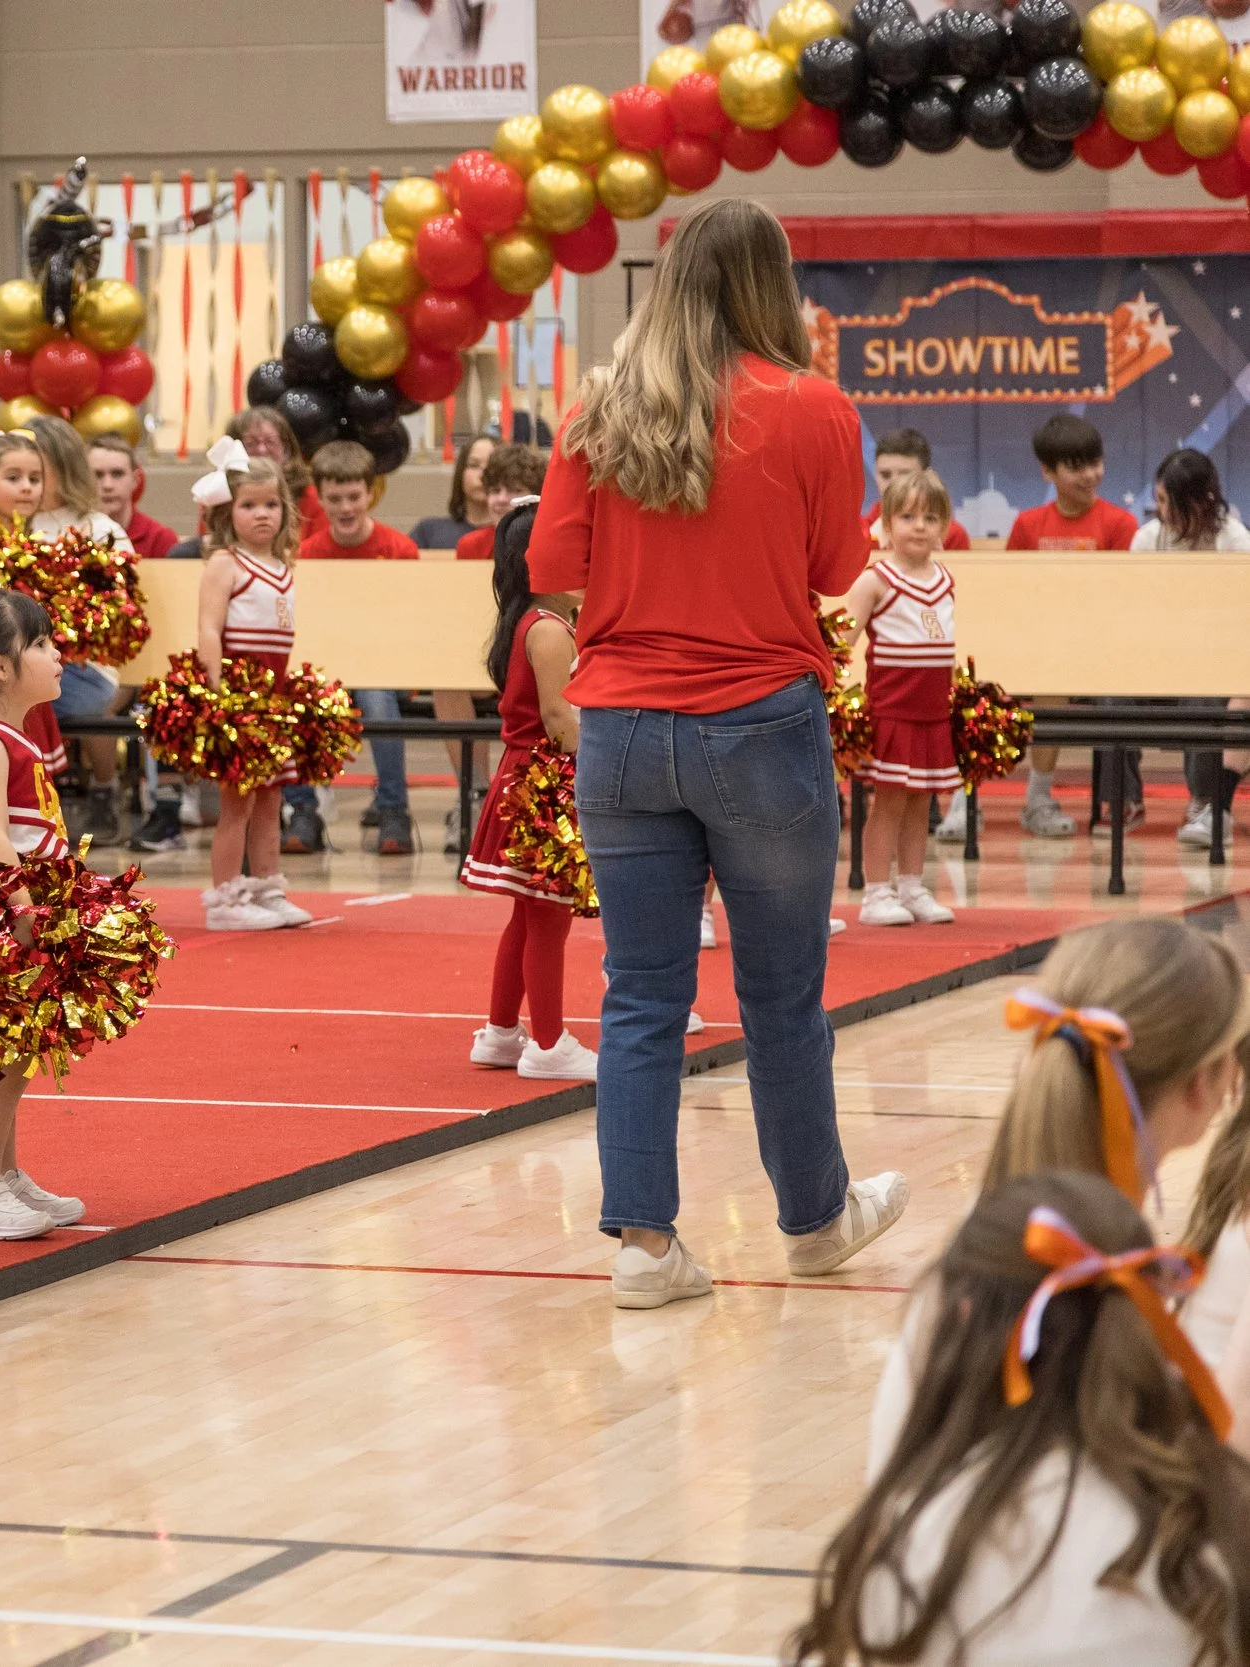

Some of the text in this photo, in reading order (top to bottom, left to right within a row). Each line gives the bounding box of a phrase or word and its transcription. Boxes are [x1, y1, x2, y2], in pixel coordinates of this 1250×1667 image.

[397, 62, 527, 93] WARRIOR
[863, 336, 1080, 377] SHOWTIME
[921, 611, 945, 639] CA
